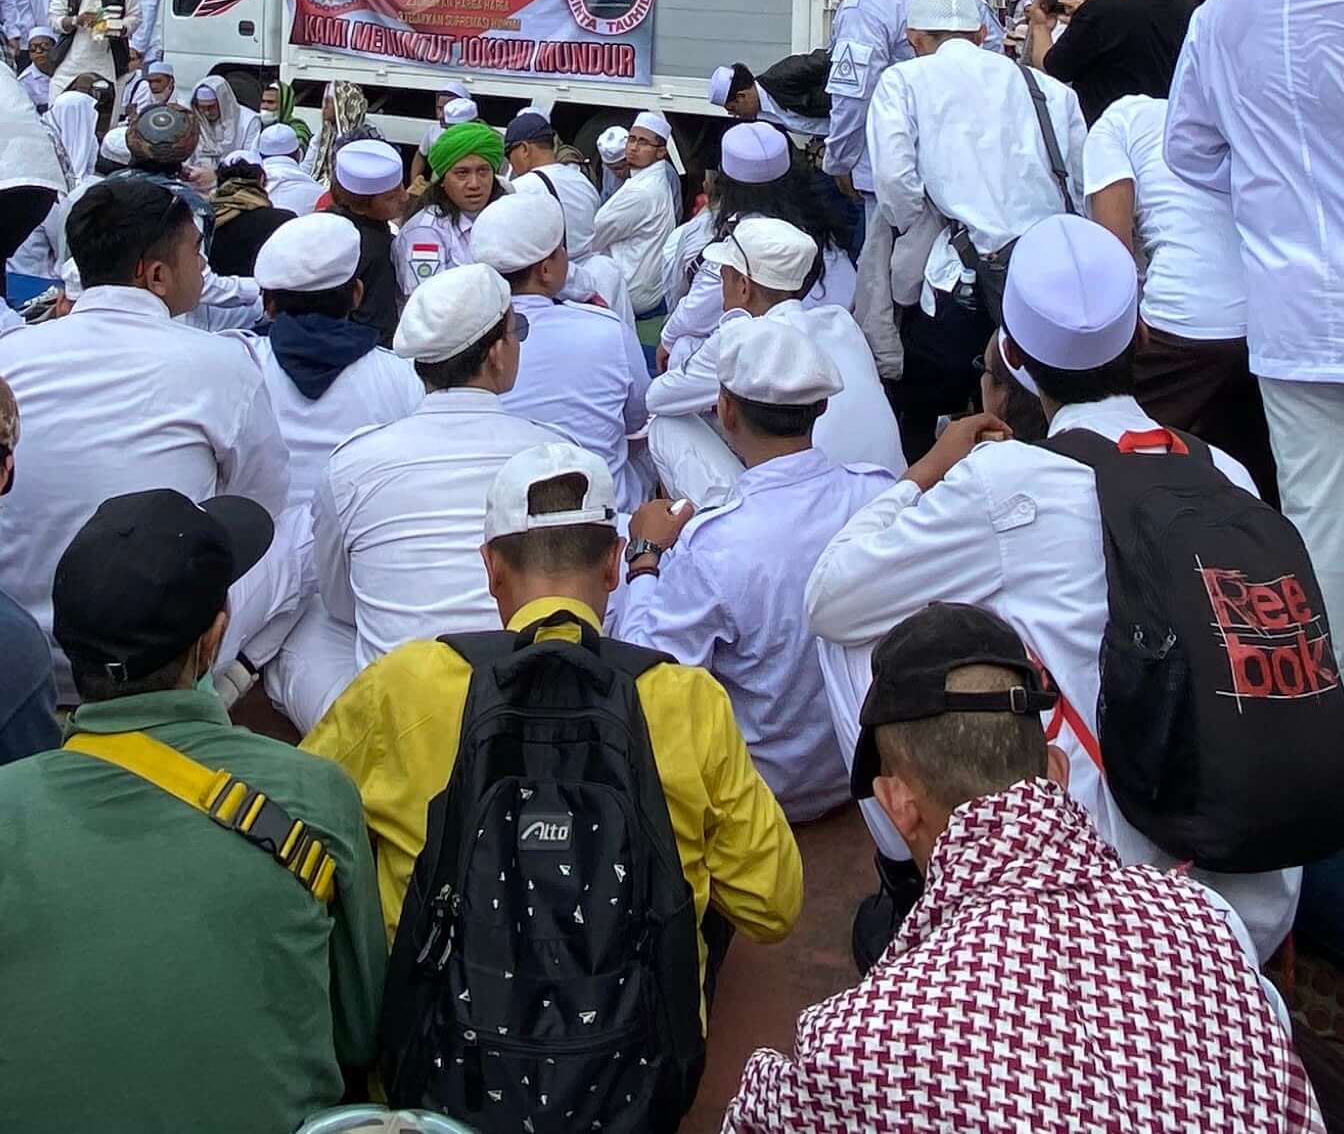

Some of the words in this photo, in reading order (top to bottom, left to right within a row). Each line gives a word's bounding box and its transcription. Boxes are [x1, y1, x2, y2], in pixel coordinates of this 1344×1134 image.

[305, 15, 350, 48] KAMI
[458, 34, 536, 72] JOKOWI
[535, 41, 636, 78] MUNDUR
[1203, 567, 1312, 629] Ree
[1226, 629, 1338, 698] bok
[520, 821, 569, 841] Alto
